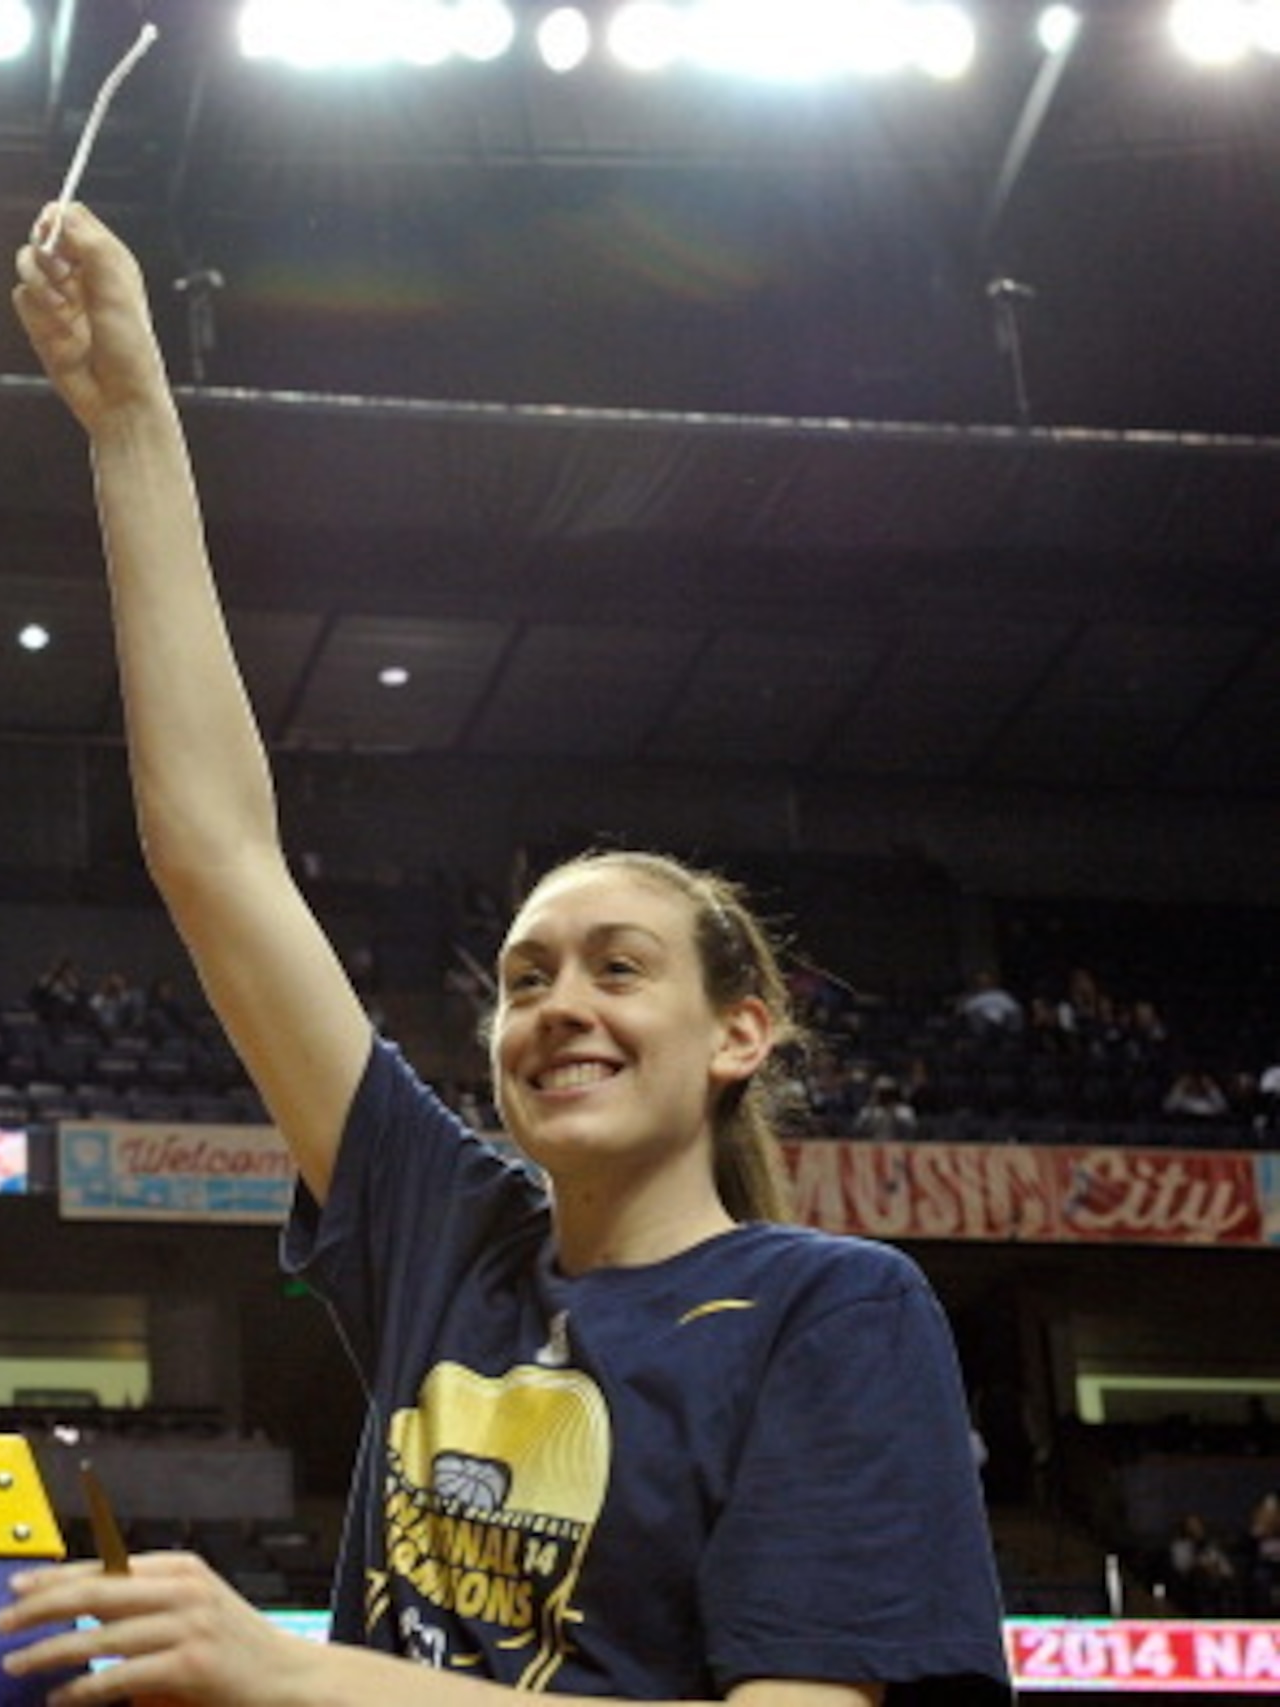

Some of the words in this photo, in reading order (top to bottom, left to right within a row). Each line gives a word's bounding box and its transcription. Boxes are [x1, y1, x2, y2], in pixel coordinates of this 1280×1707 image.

[121, 1132, 291, 1174] Welcom
[1068, 1151, 1248, 1244] City
[1020, 1629, 1176, 1678] 2014
